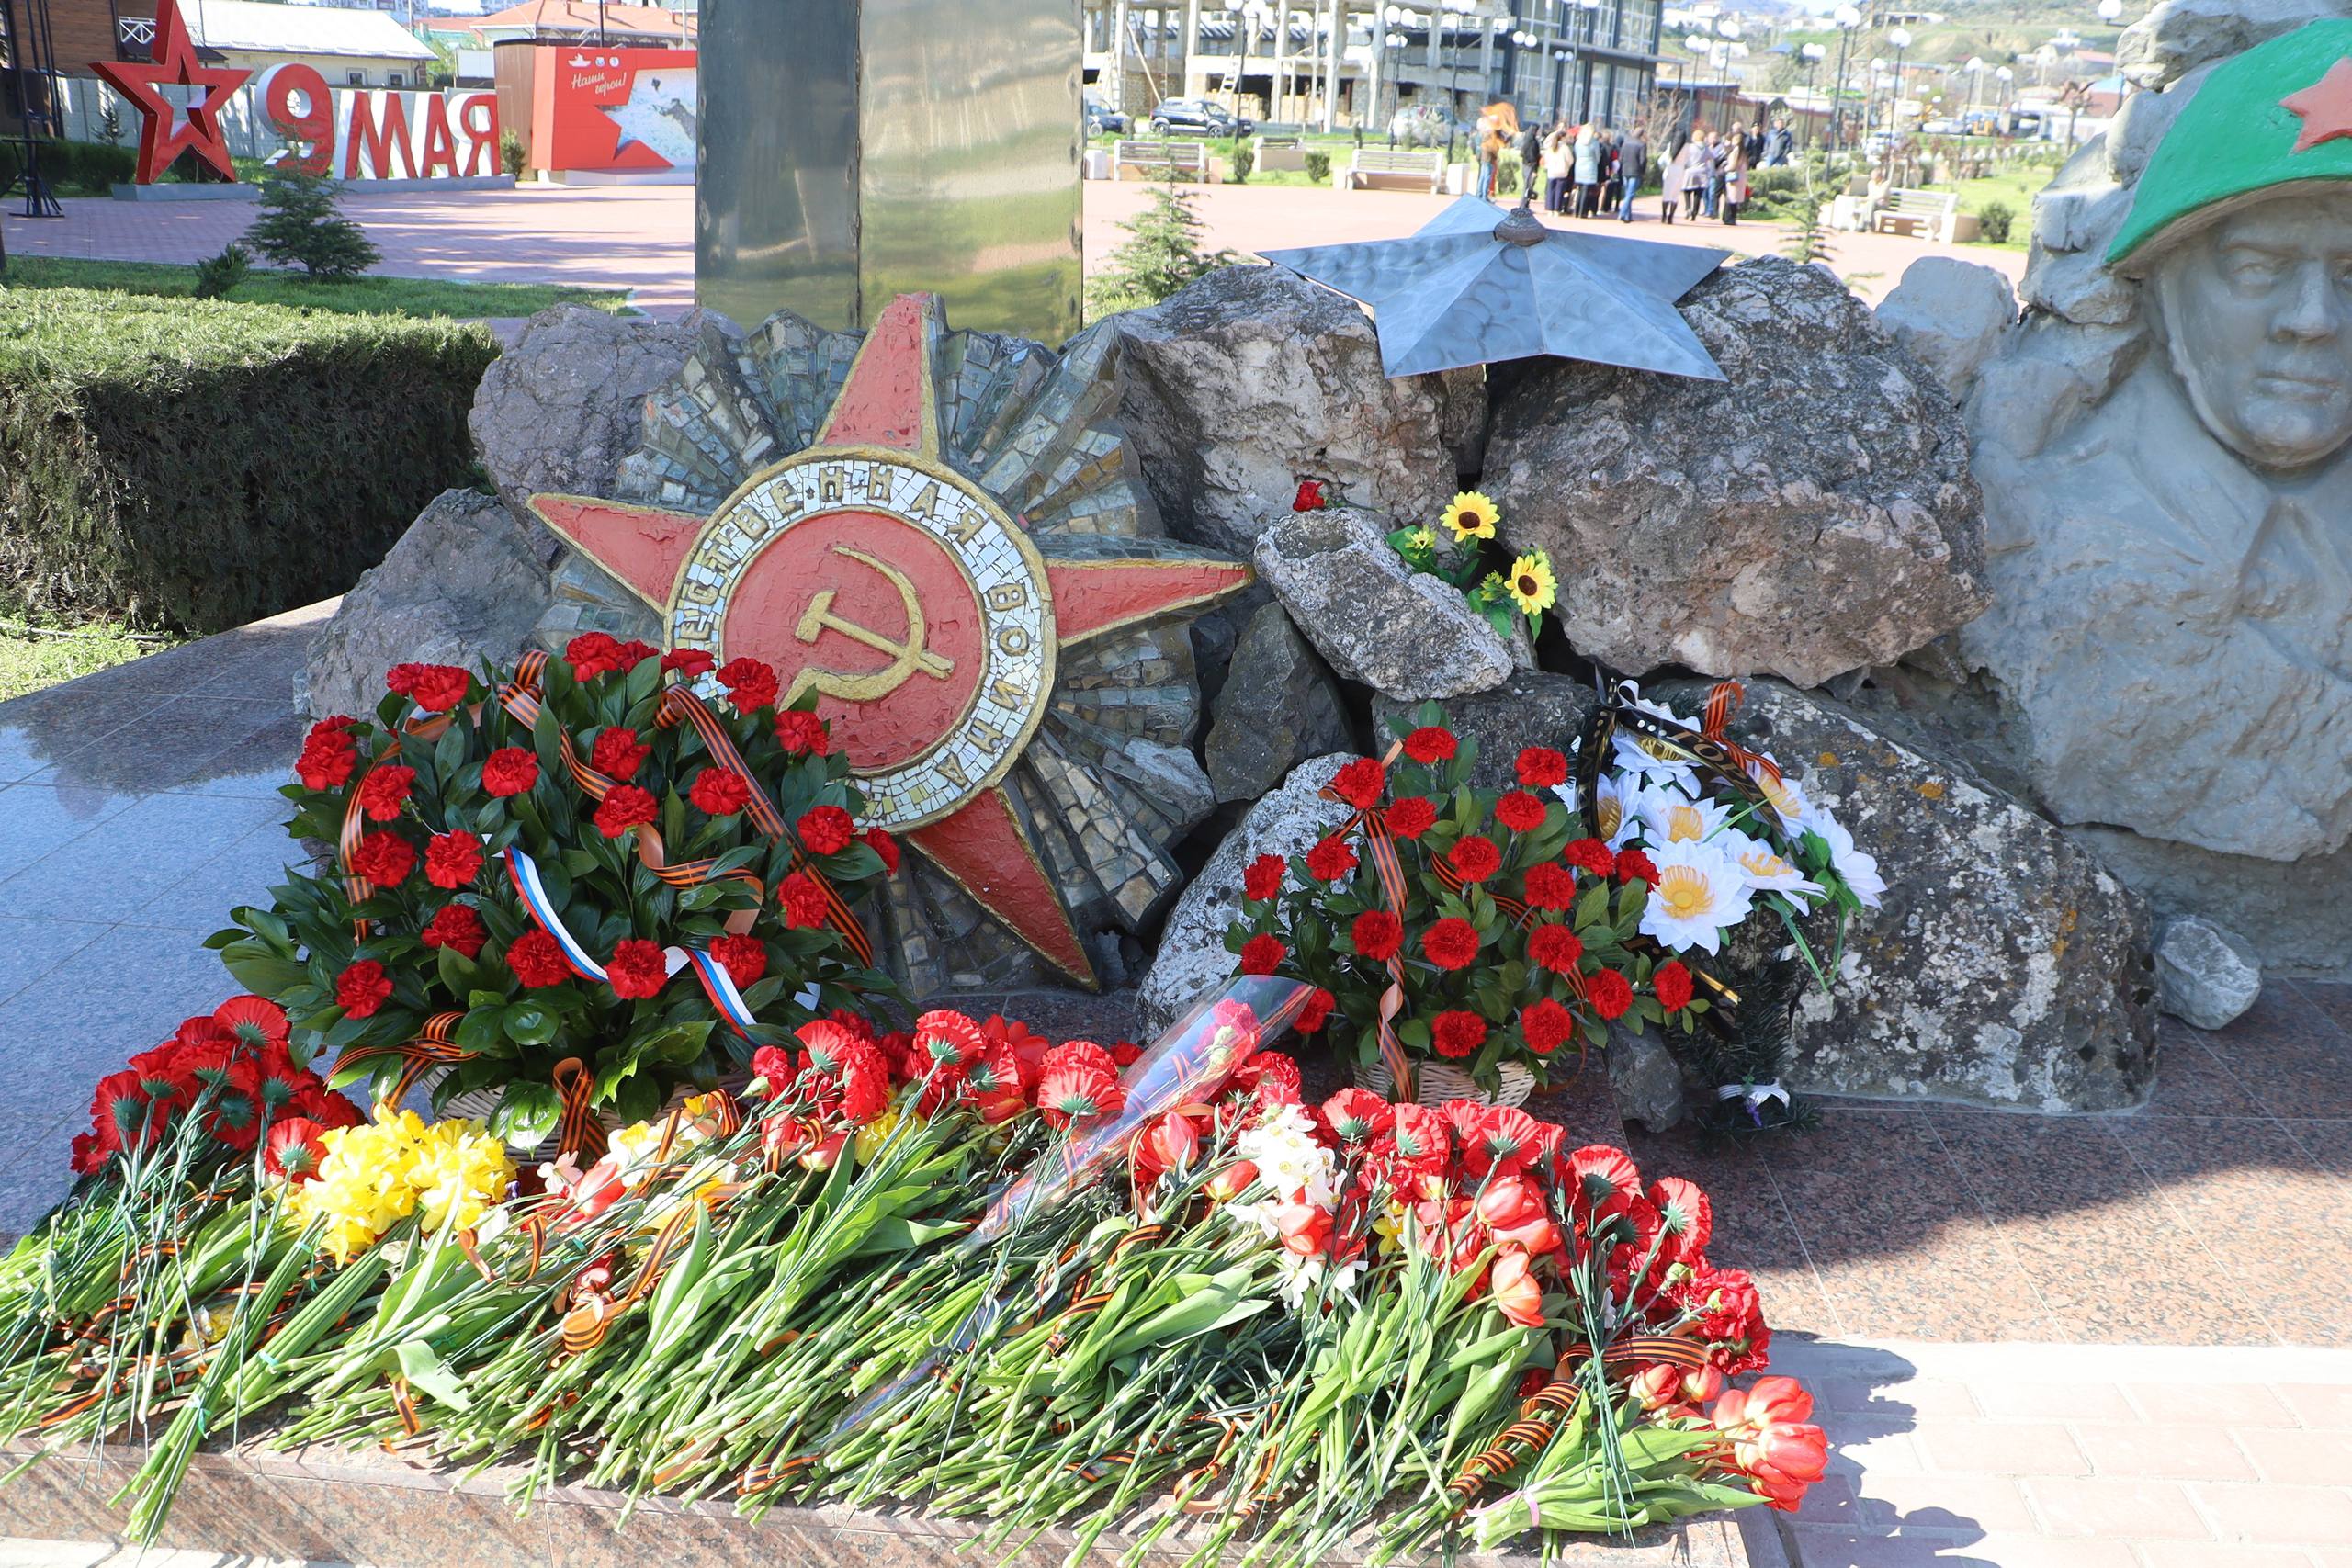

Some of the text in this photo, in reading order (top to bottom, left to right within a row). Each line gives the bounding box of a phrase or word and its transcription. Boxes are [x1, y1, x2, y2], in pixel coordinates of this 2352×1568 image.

[571, 71, 605, 89] Наши
[595, 72, 628, 96] герои!
[256, 62, 502, 179] 9 МАЯ
[679, 465, 985, 639] ЕСТВЕННАЯ
